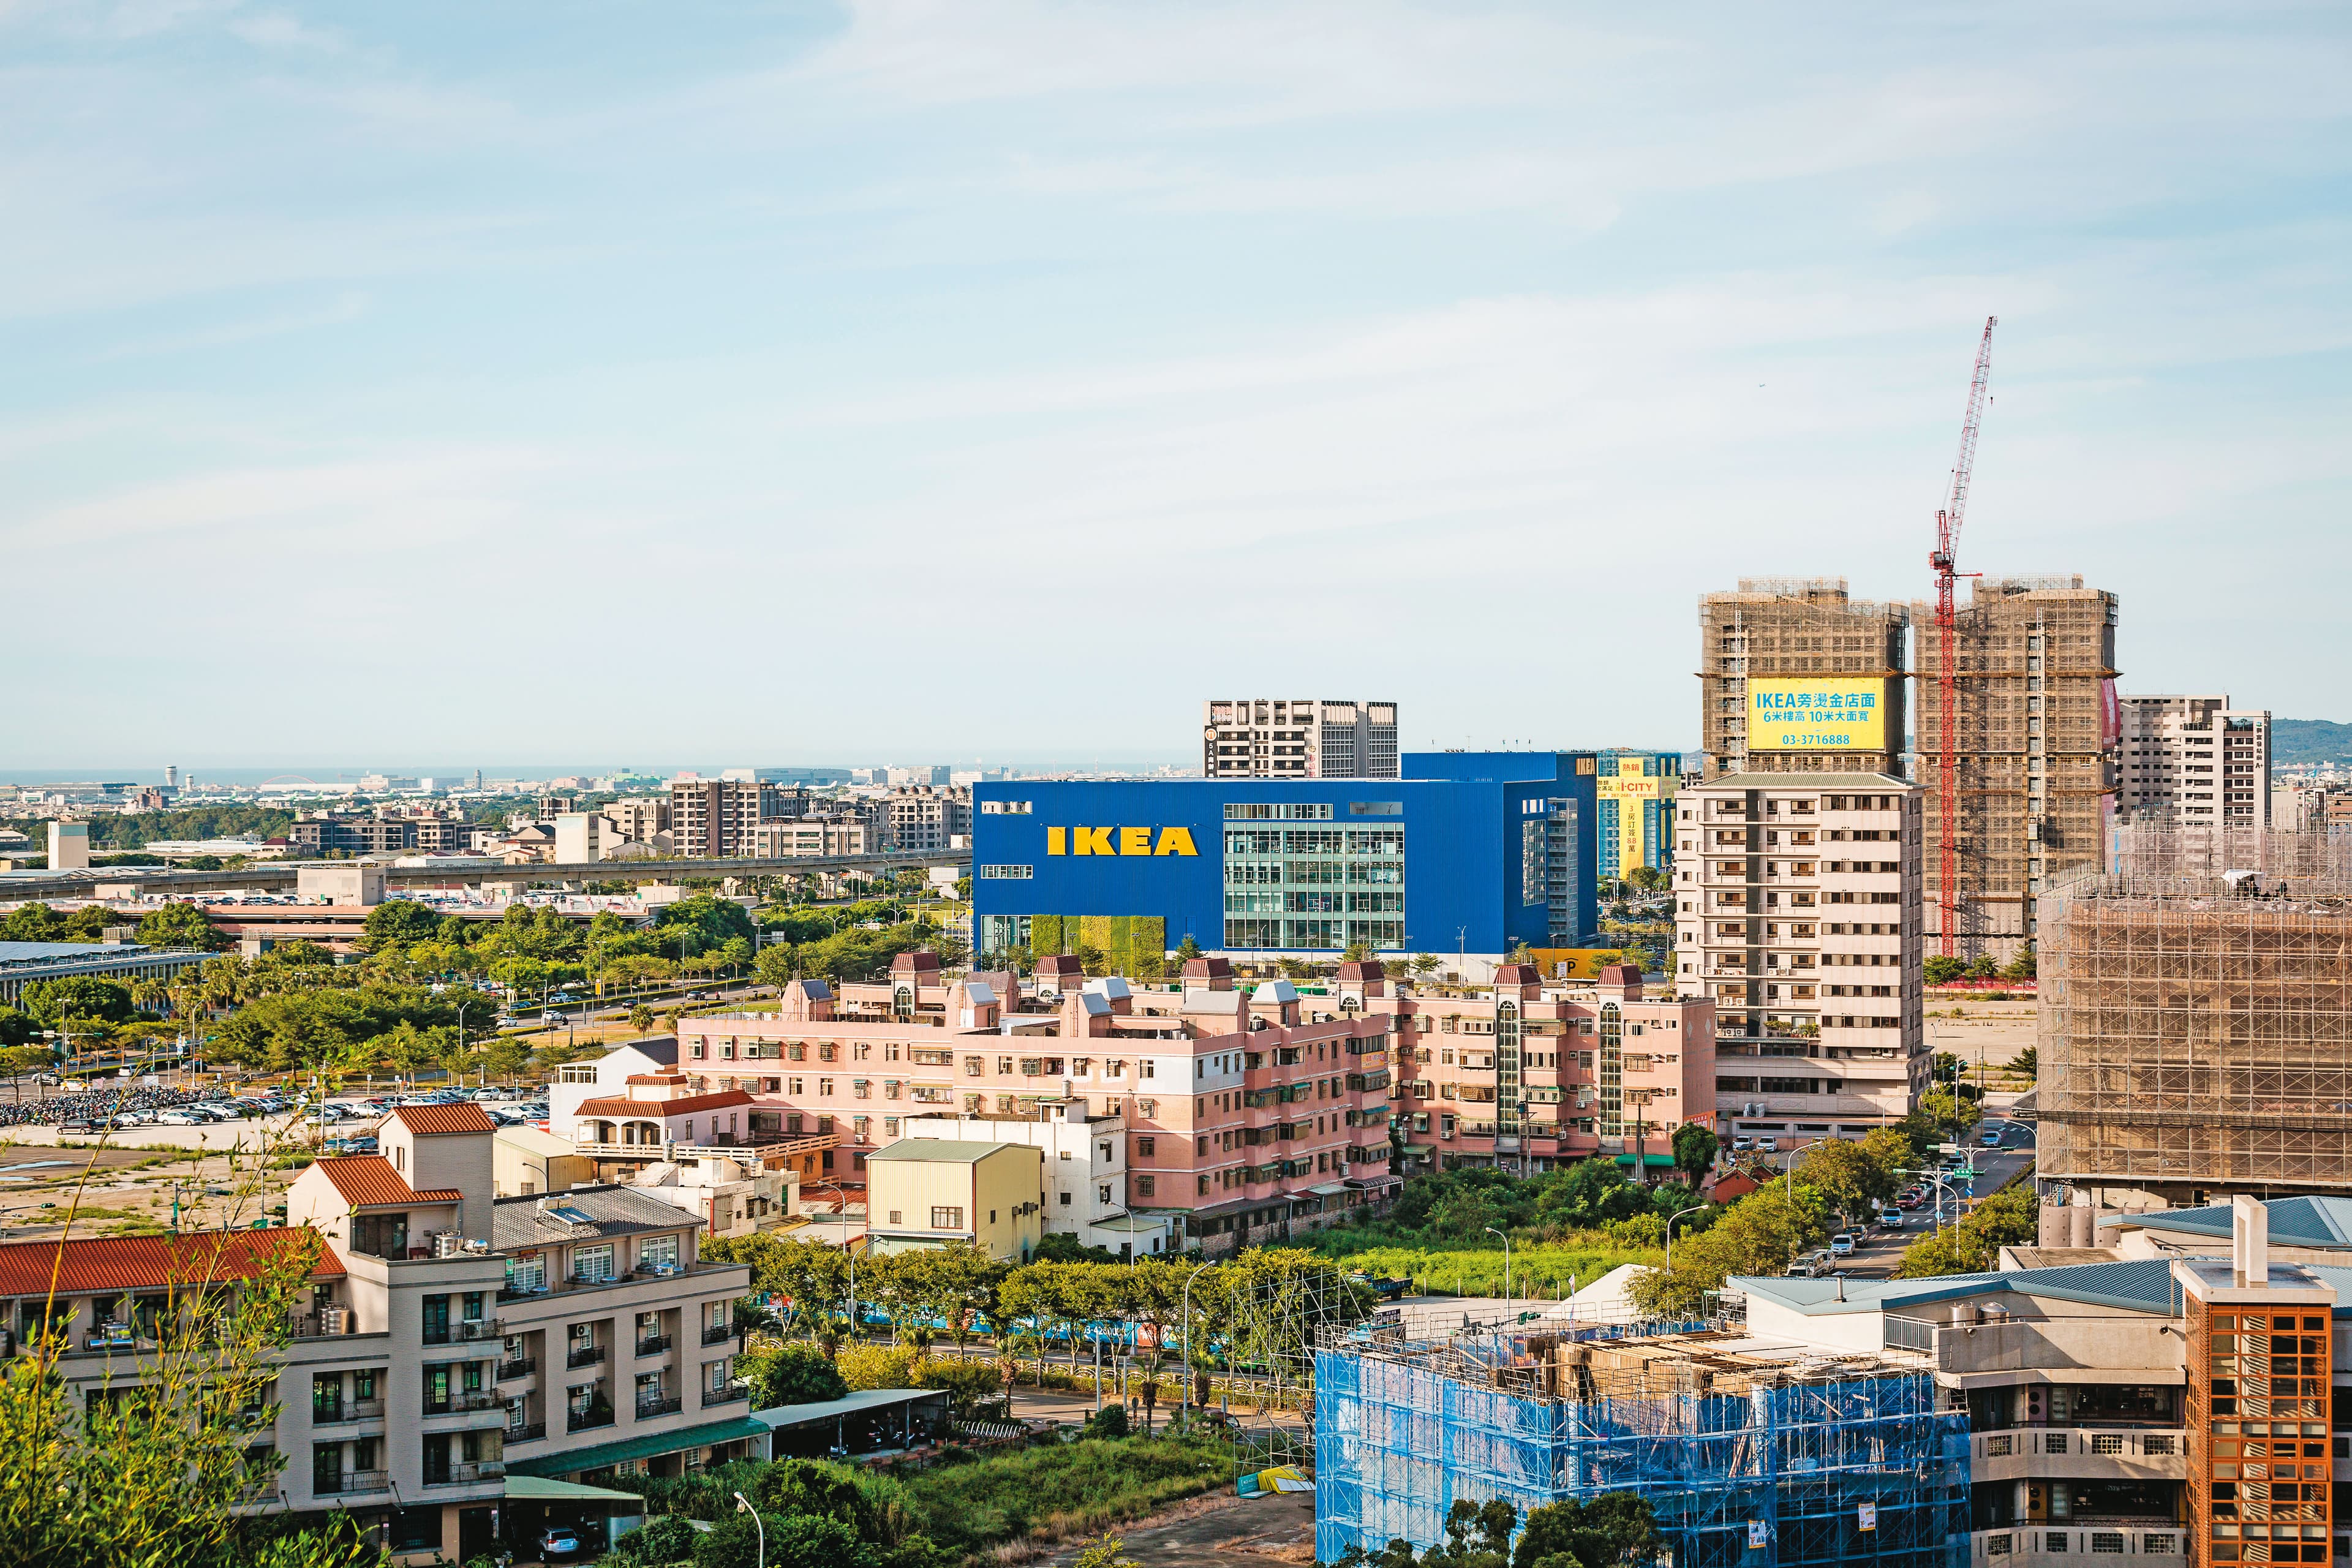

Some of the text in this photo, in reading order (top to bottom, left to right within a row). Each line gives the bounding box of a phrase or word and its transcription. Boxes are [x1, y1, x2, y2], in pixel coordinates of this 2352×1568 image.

[1757, 693, 1875, 708] IKEA旁燙金店面
[1763, 710, 1805, 722] 6米樓高
[1782, 734, 1850, 745] 03-3716888
[1576, 758, 1596, 775] IKEA
[1047, 826, 1199, 856] IKEA
[1567, 961, 1575, 973] P
